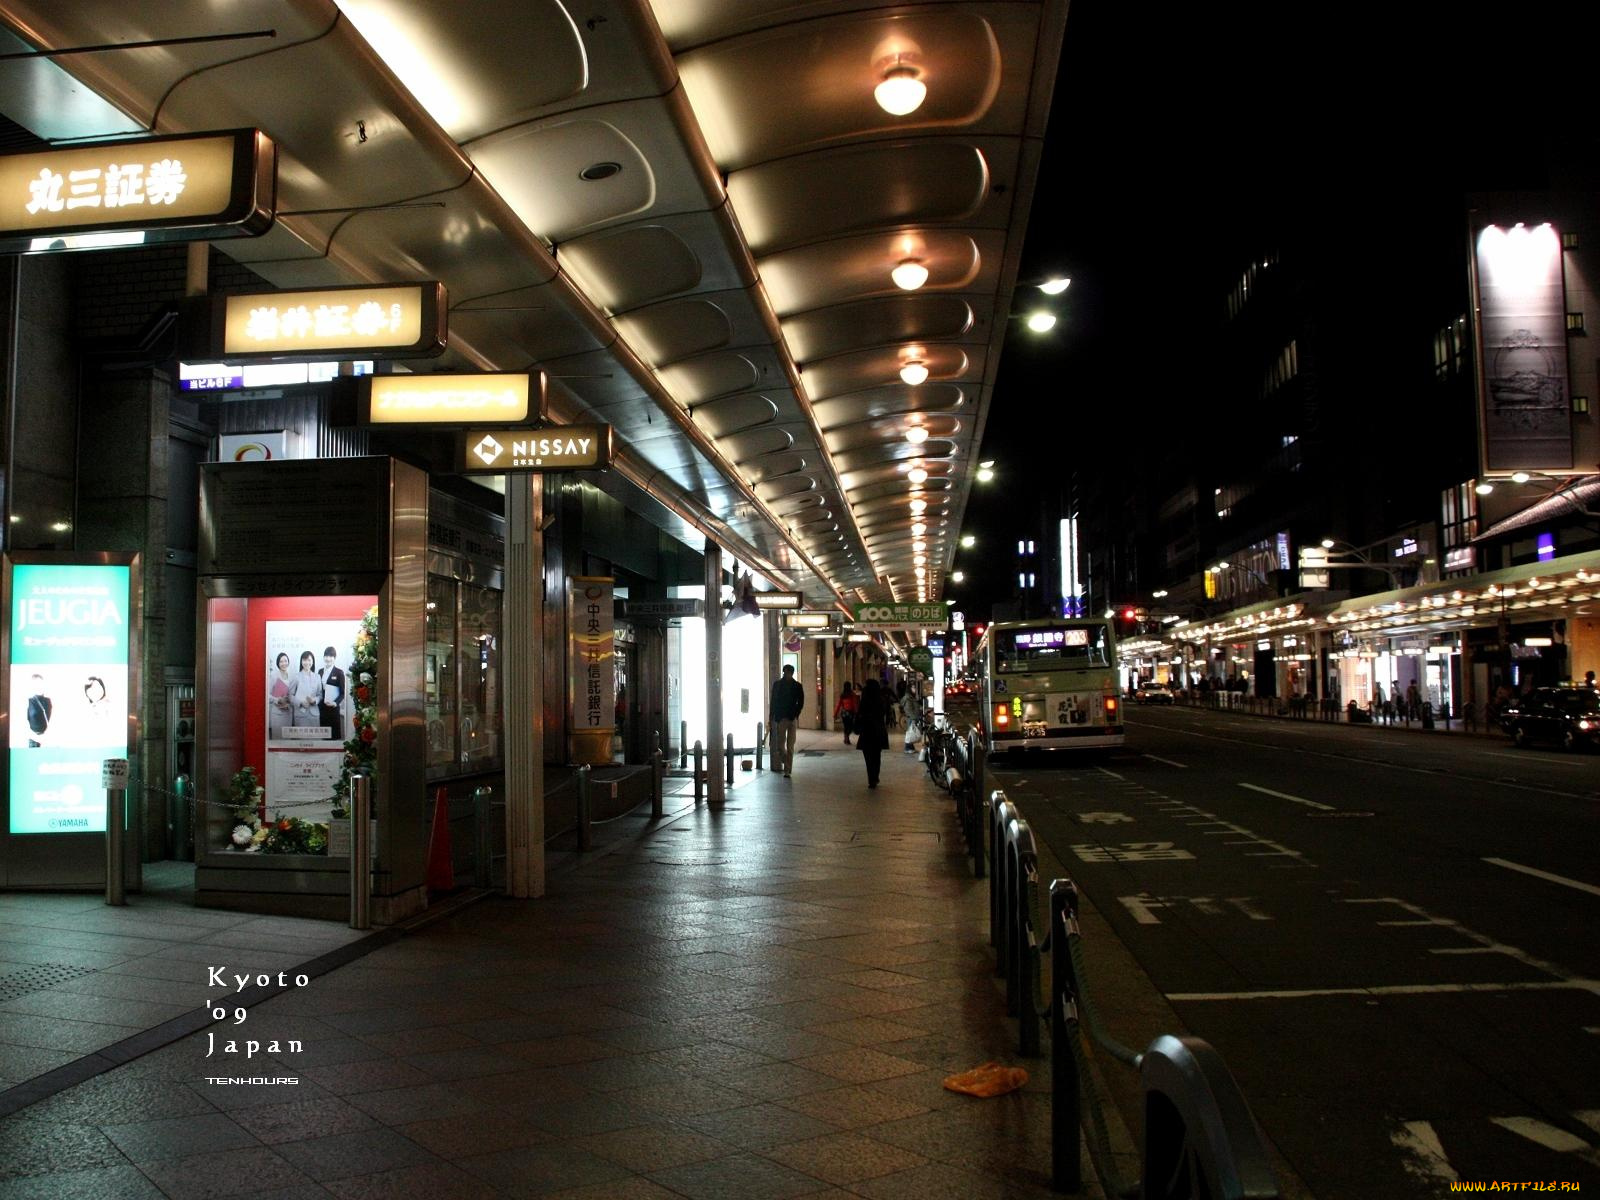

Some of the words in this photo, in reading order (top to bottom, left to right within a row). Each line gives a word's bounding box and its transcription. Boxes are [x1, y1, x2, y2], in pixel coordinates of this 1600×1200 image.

[26, 158, 187, 214] 丸三証券
[512, 438, 592, 457] NISSAY
[18, 598, 122, 632] JEUGIA
[912, 607, 942, 619] のりば
[586, 602, 602, 727] 中央三井信託銀行
[58, 818, 89, 828] YAMAHA
